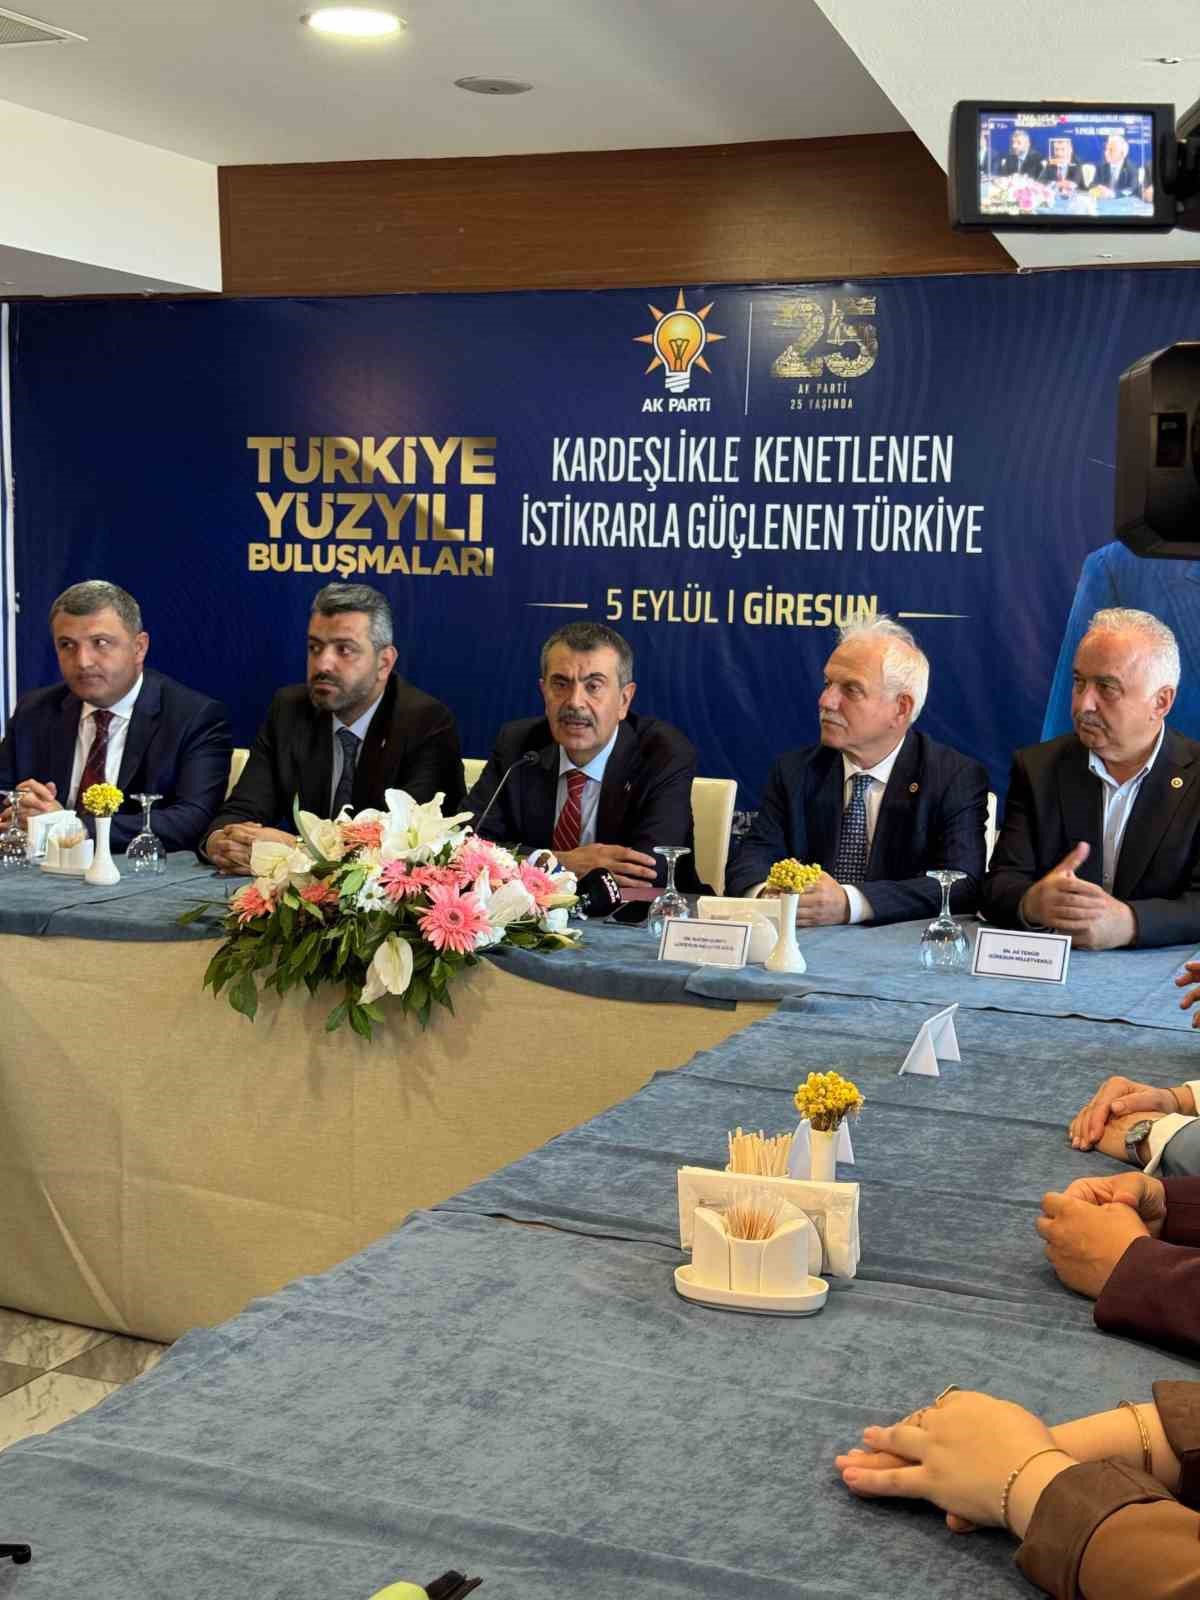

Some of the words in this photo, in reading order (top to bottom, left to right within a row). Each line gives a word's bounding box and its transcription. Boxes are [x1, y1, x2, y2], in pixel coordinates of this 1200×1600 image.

[771, 296, 879, 378] 25
[641, 398, 664, 413] AK
[668, 397, 711, 412] PARTİ
[790, 399, 802, 411] 25
[816, 381, 847, 394] PARTİ
[247, 436, 497, 485] TÜRKİYE
[552, 428, 741, 491] KARDEŞLİKLE
[753, 435, 953, 483] KENETLENEN
[256, 492, 484, 541] YÜZYILI
[521, 493, 680, 548] İSTİKRARLA
[687, 494, 845, 559] GÜÇLENEN
[852, 495, 985, 553] TÜRKİYE
[247, 543, 494, 579] BULUŞMALARI
[606, 588, 623, 621] 5
[632, 583, 719, 623] EYLÜL
[744, 585, 878, 627] GİRESUN
